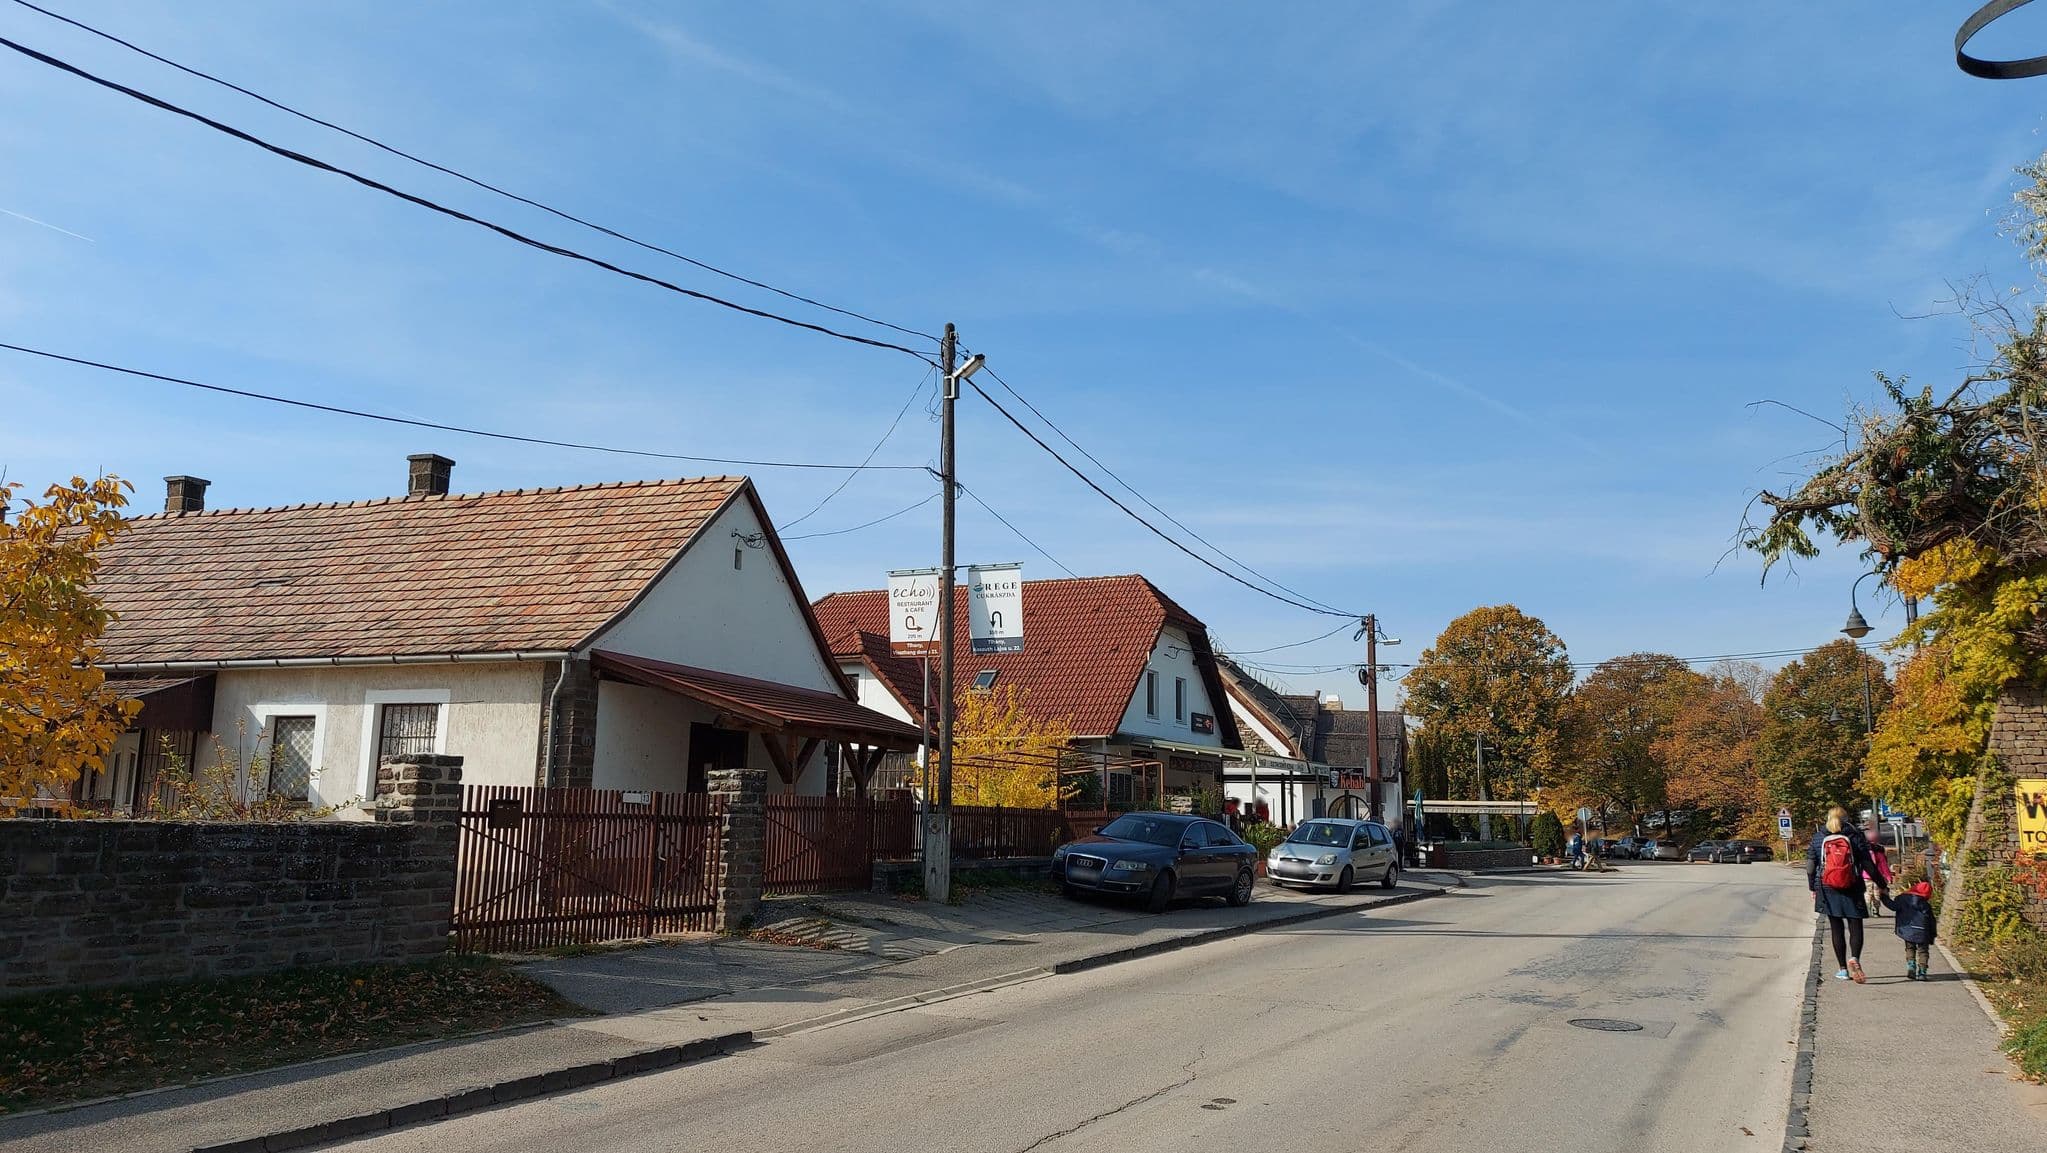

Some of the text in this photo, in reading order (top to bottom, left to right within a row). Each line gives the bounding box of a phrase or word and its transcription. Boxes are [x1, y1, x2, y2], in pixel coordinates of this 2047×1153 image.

[893, 579, 925, 598] echo
[985, 582, 1017, 591] REGE
[1340, 774, 1364, 789] Kebab
